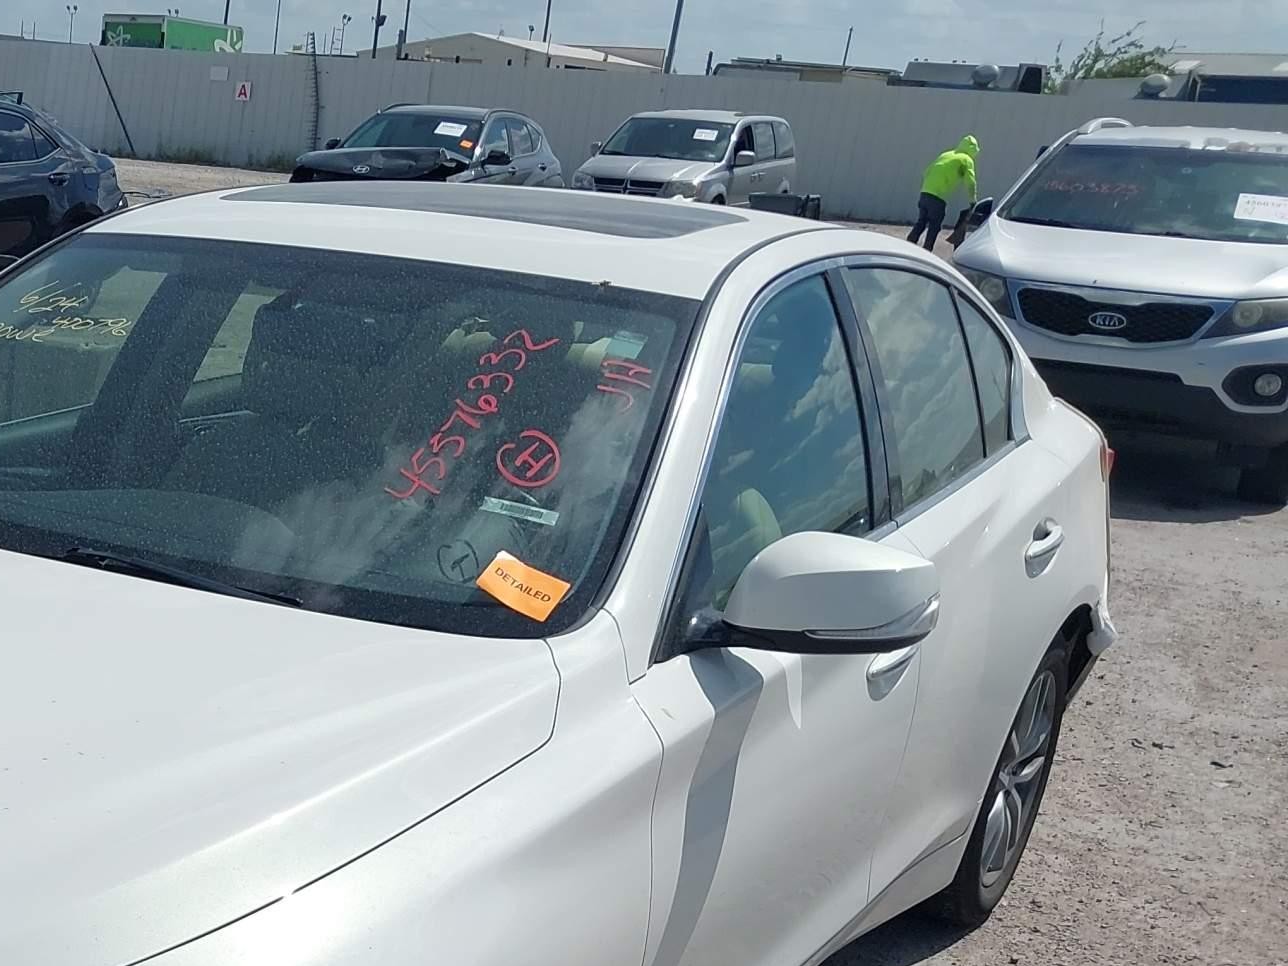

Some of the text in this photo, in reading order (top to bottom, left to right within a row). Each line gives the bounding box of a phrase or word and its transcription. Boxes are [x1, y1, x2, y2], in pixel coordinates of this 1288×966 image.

[237, 83, 248, 99] A
[383, 328, 561, 500] 45576332
[494, 566, 552, 603] DETAILED
